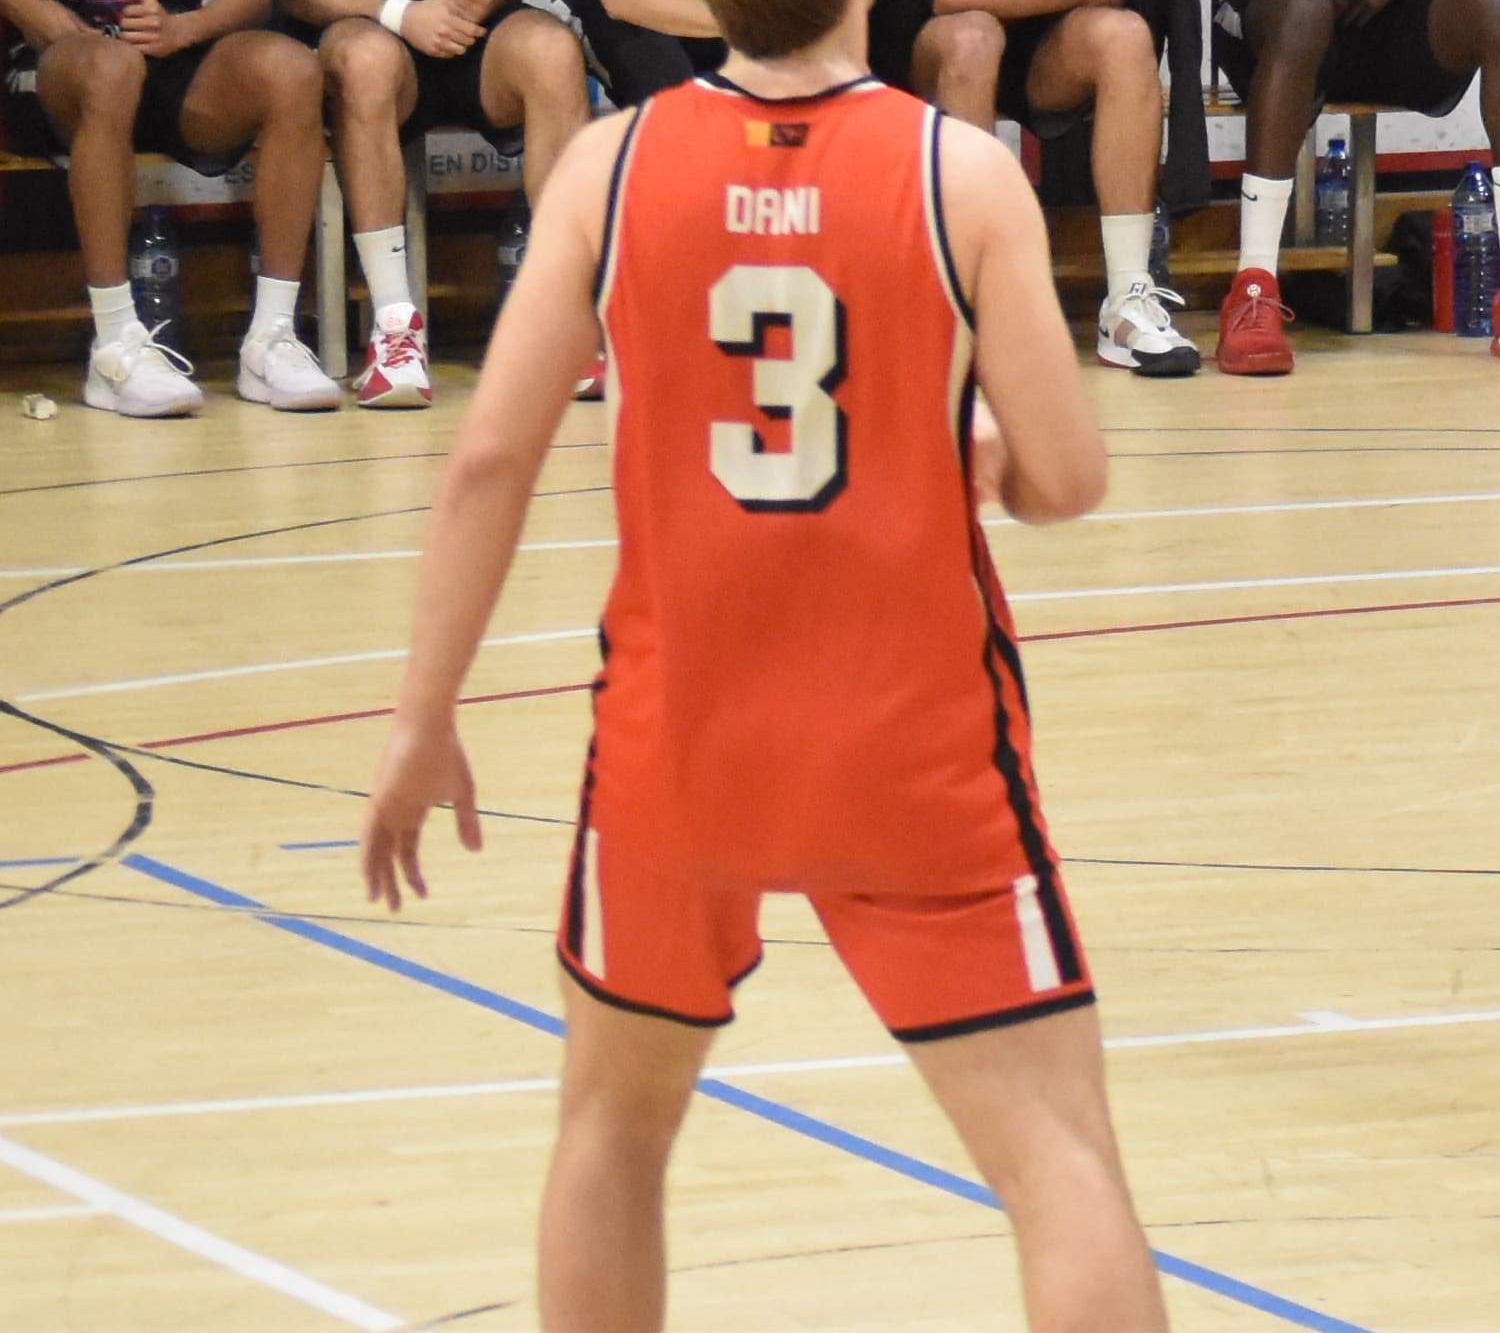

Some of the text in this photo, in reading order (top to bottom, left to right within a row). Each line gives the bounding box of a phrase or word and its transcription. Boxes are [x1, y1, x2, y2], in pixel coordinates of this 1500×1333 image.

[430, 153, 464, 175] EN
[725, 184, 820, 235] DANI
[708, 264, 847, 513] 3
